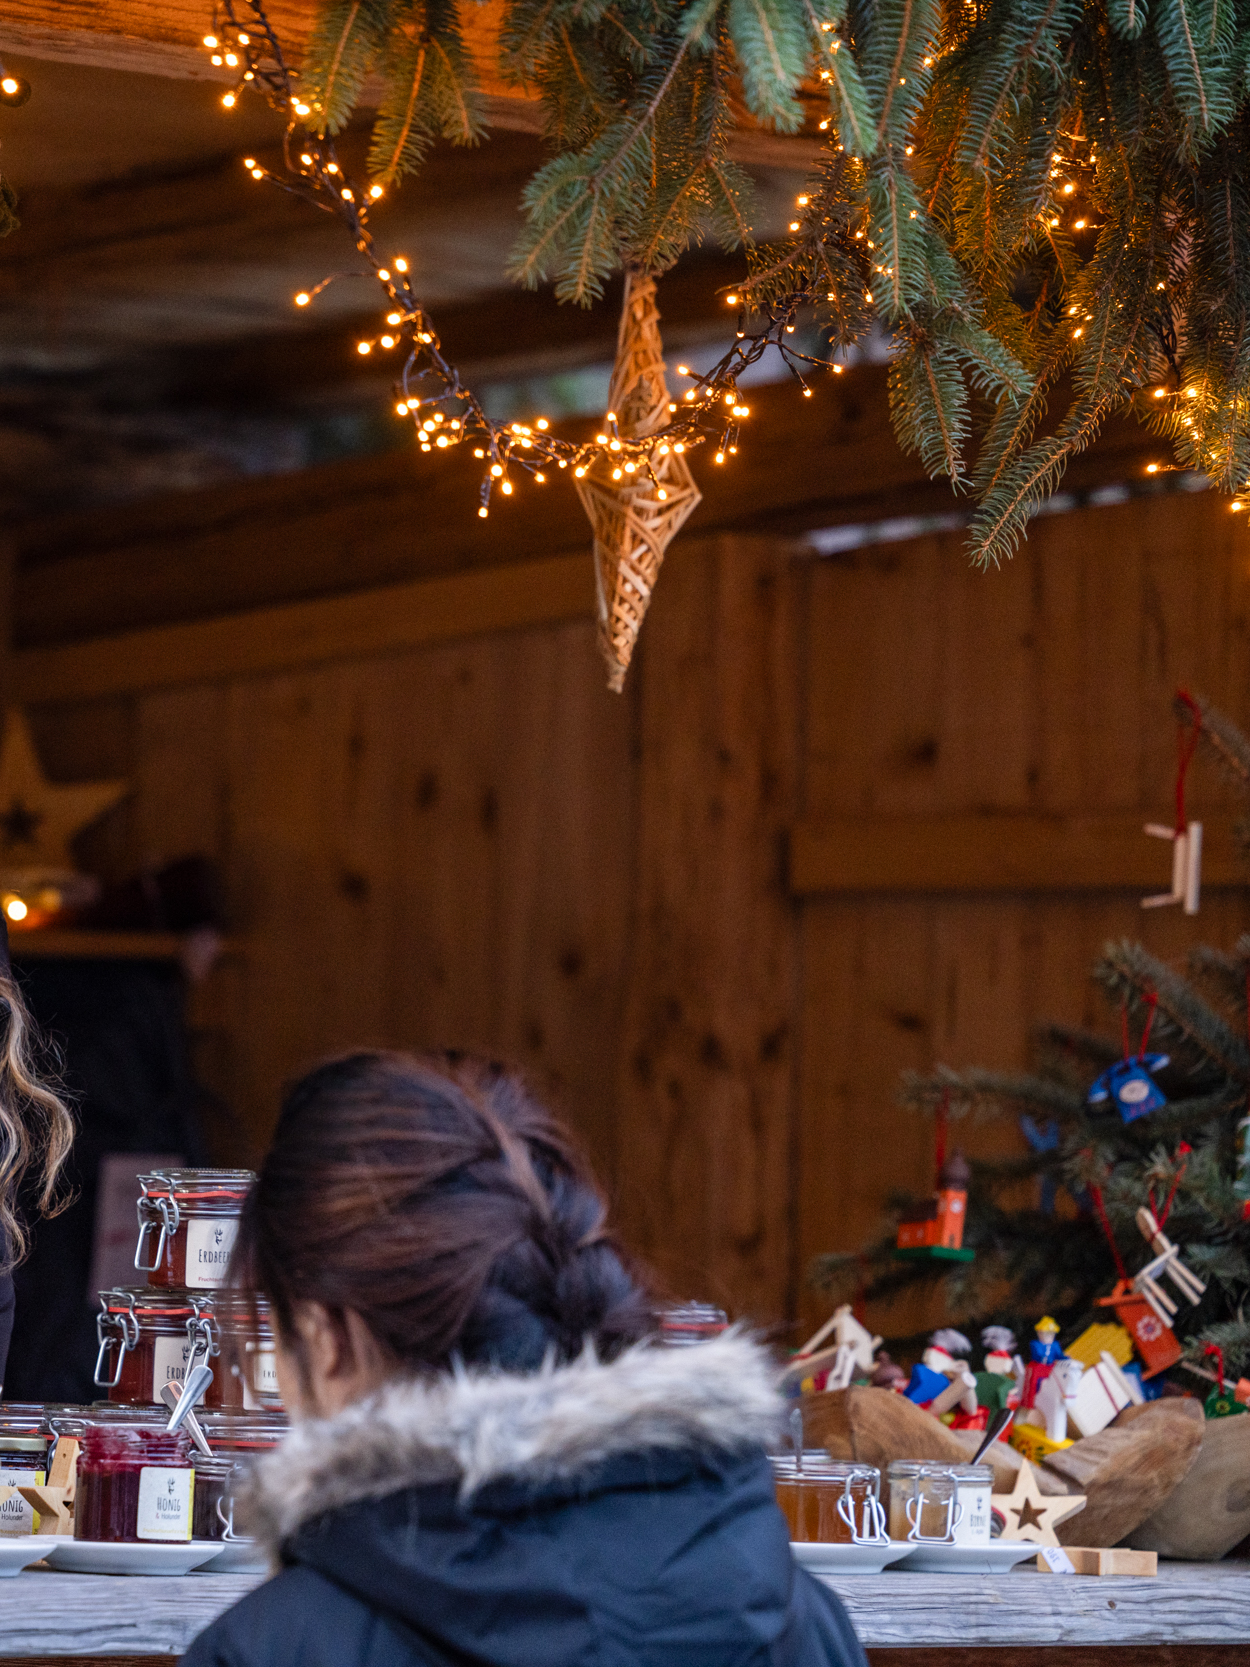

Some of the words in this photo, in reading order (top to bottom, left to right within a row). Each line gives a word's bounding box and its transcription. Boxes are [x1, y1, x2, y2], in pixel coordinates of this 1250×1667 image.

[166, 1365, 188, 1380] ERDB
[157, 1497, 182, 1512] HONIG
[1, 1513, 24, 1521] Holunder
[161, 1512, 182, 1520] Holunder
